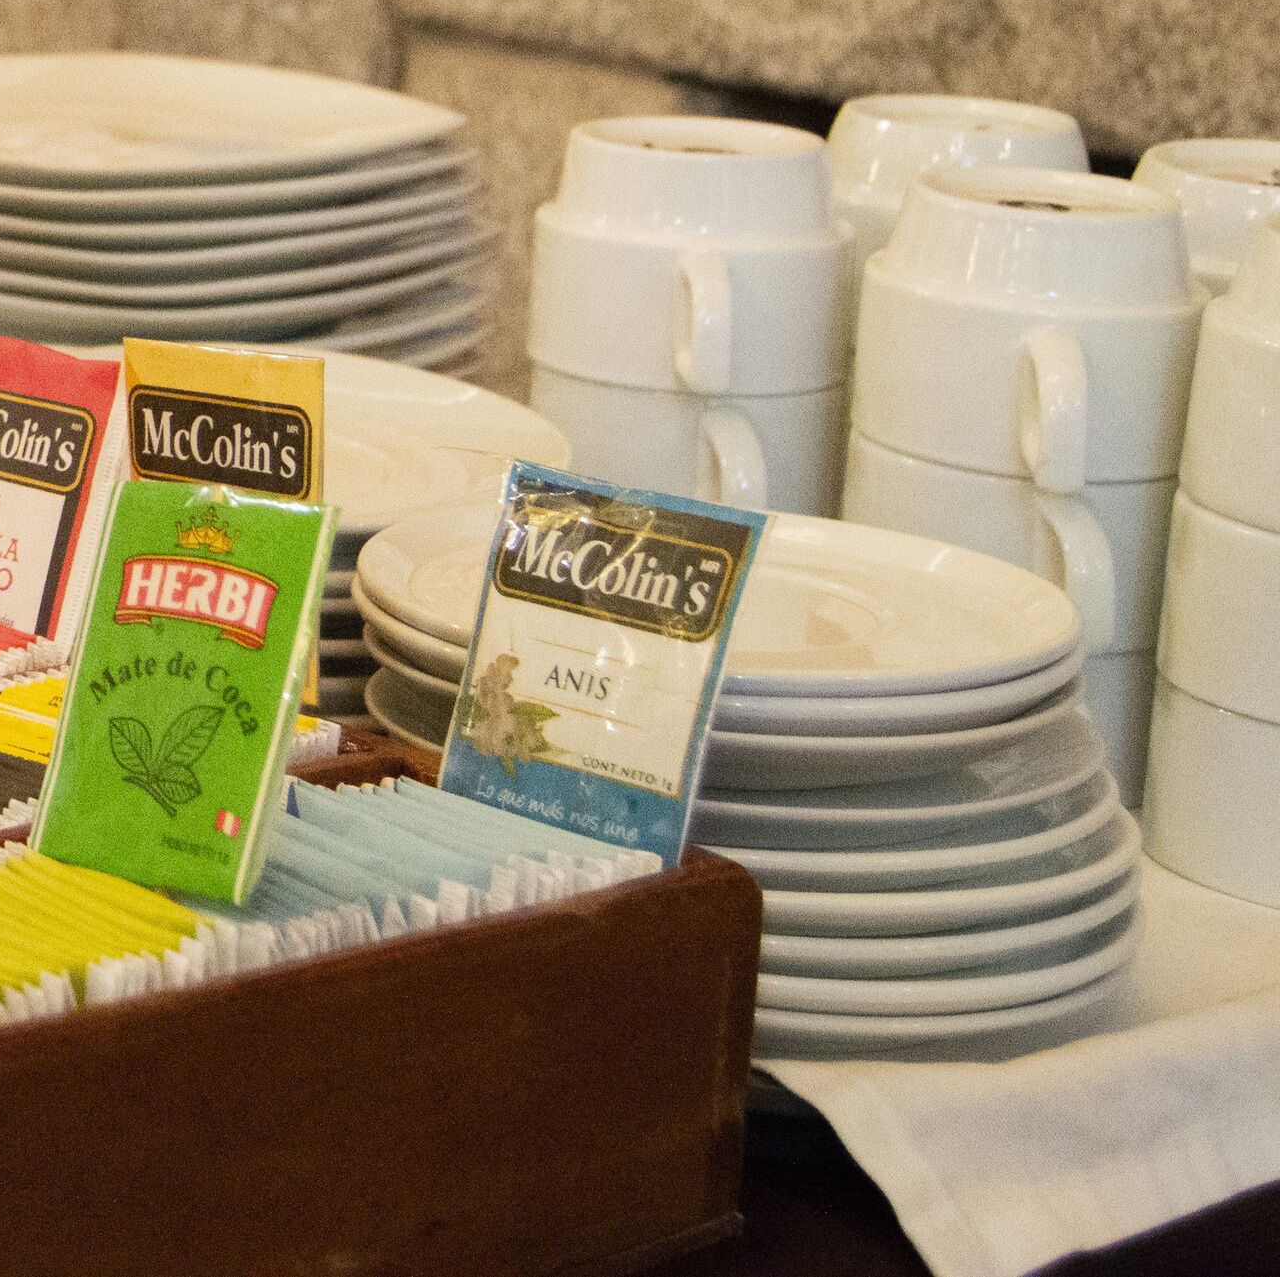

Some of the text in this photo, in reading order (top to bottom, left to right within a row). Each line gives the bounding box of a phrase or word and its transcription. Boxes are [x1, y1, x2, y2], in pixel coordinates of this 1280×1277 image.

[142, 407, 297, 479] McColin's
[126, 563, 267, 629] HERBI
[510, 522, 711, 617] McColin's
[90, 650, 259, 737] Mate de Coca
[544, 664, 611, 701] ANIS
